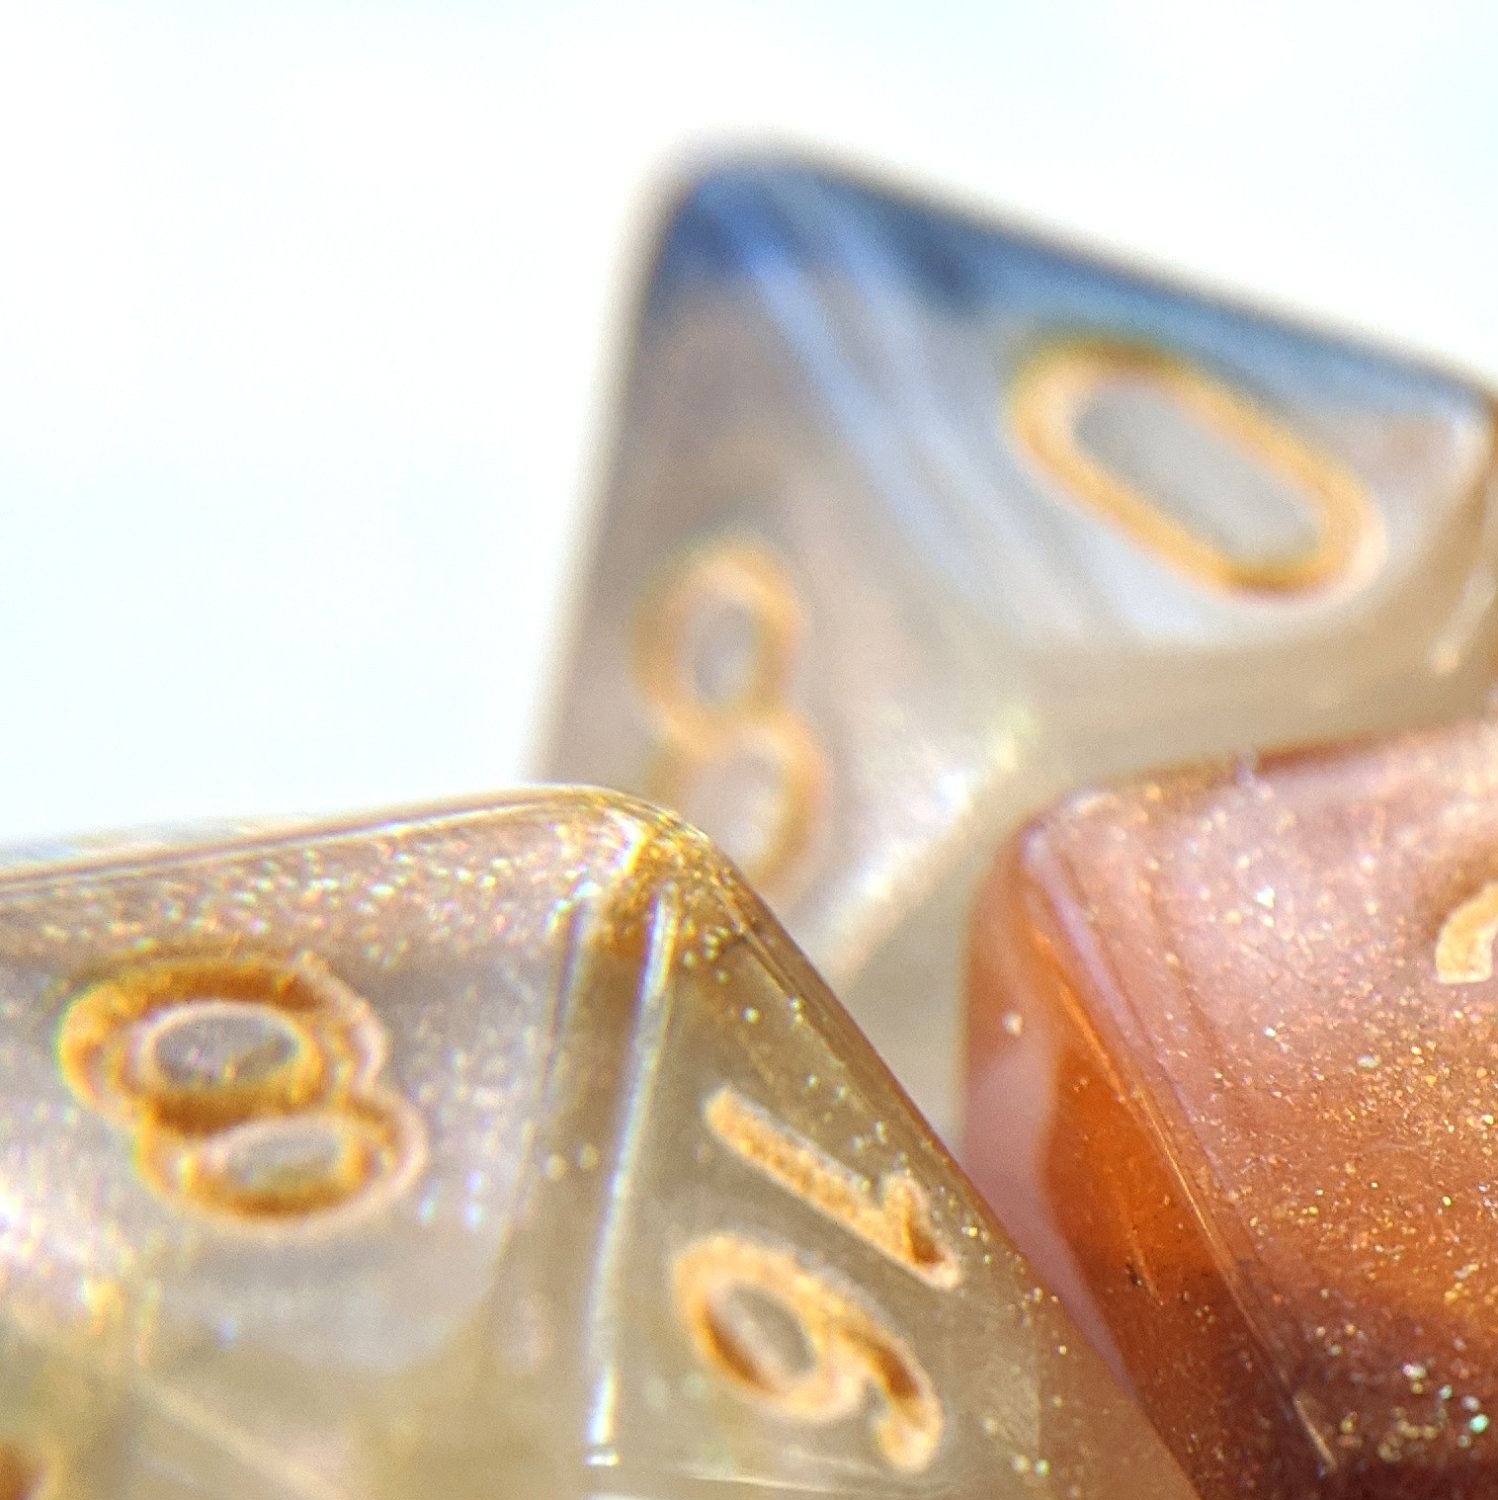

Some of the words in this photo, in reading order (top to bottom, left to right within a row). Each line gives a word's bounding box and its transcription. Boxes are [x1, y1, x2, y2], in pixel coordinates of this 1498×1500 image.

[1009, 325, 1384, 606] 0
[625, 527, 832, 895] 8
[56, 945, 428, 1245] 8
